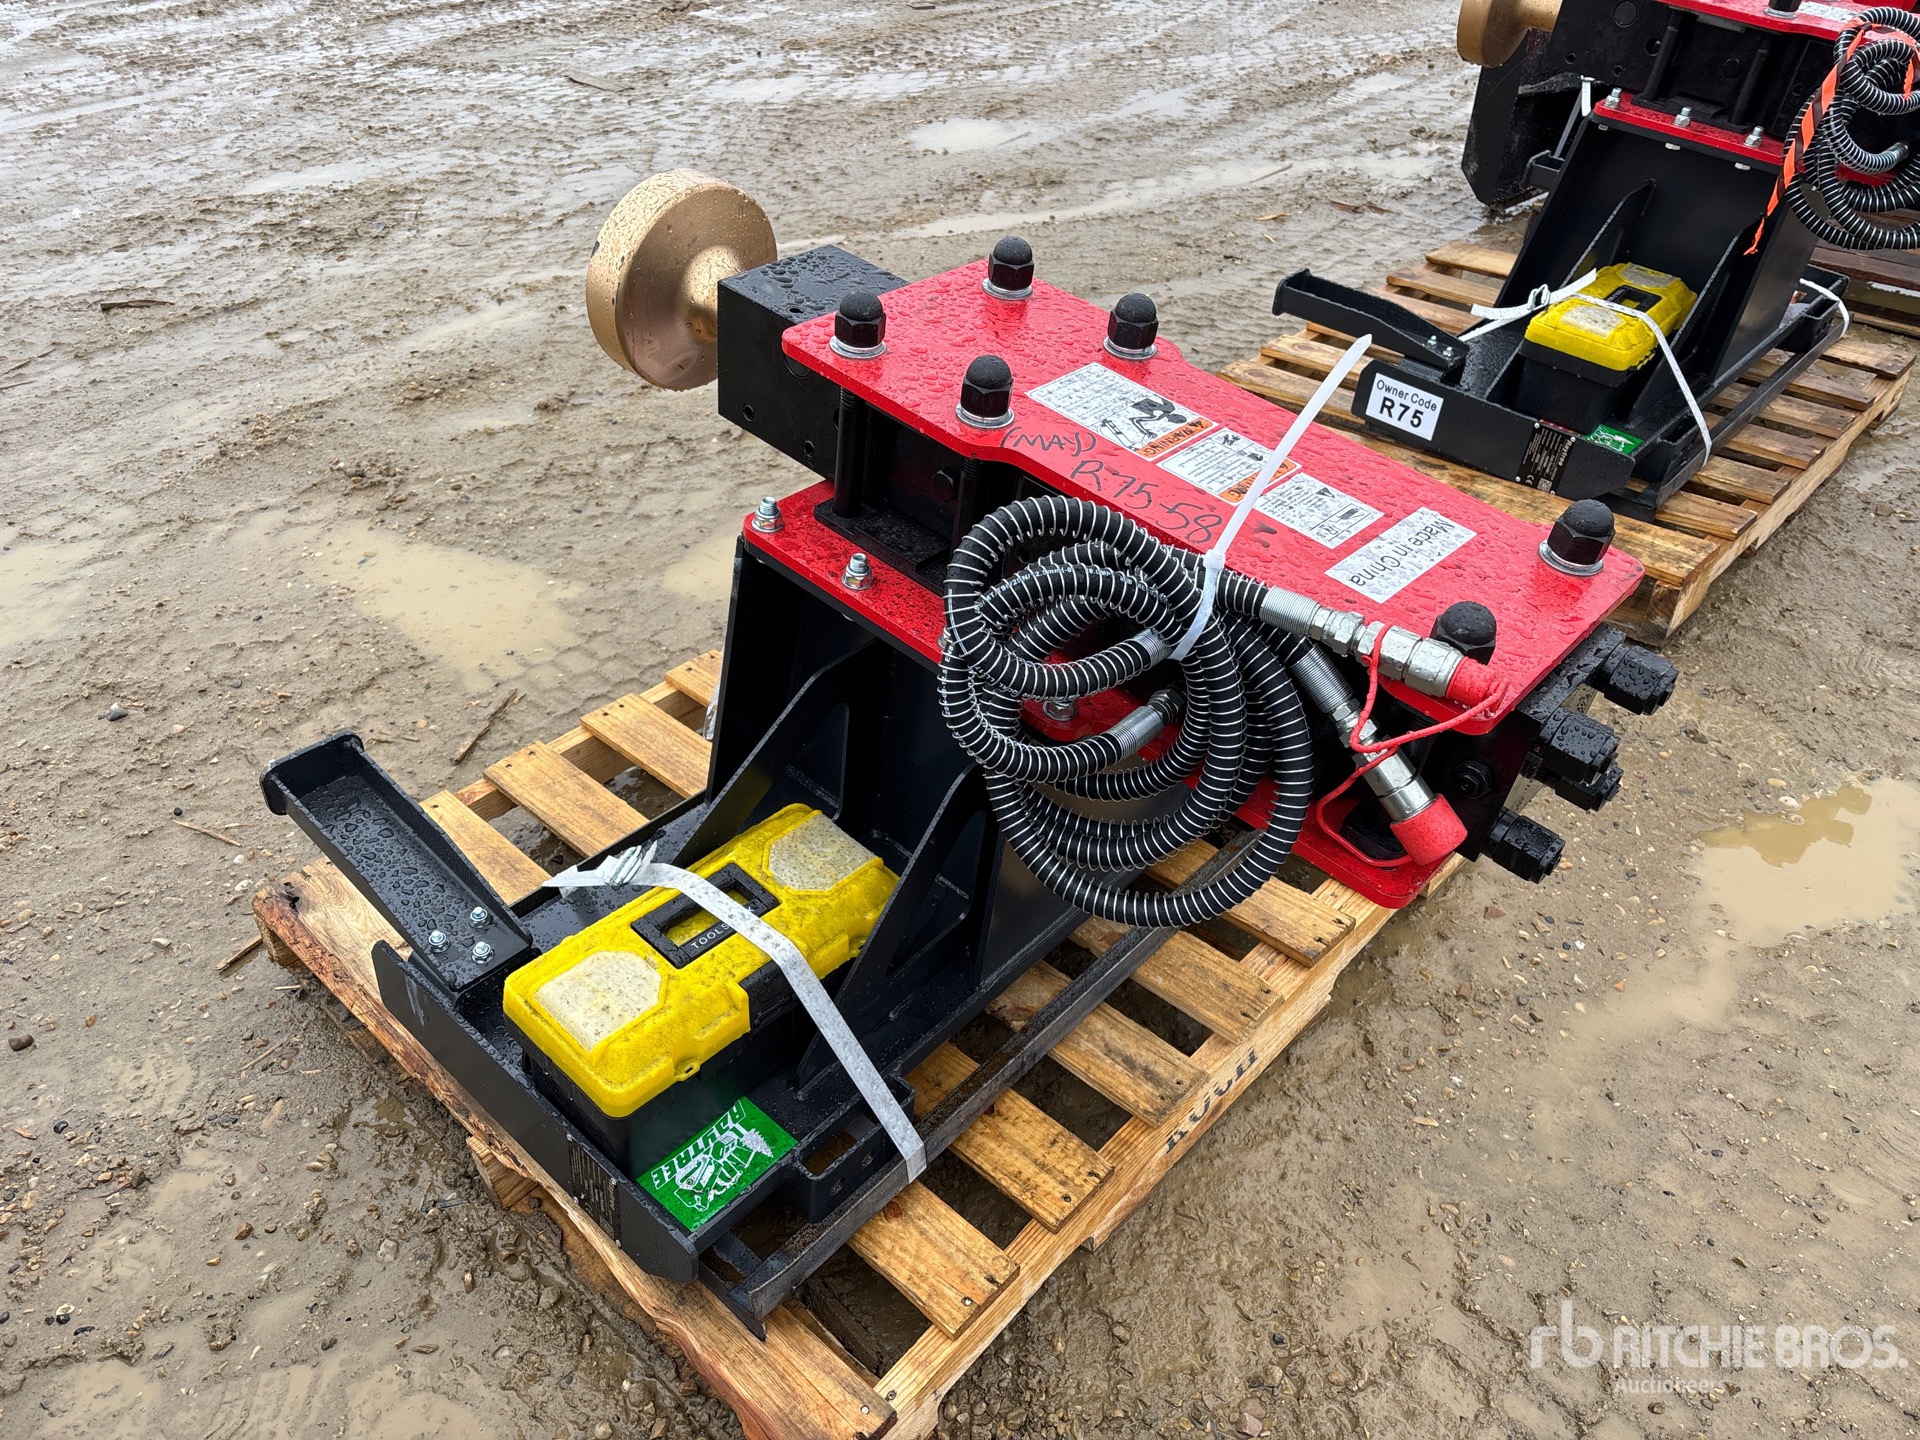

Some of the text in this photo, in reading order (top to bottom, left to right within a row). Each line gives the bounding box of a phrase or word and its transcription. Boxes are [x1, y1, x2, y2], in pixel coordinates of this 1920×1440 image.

[1376, 379, 1437, 412] Owner Code
[1379, 396, 1424, 428] R75
[1143, 426, 1195, 456] WARNING
[1349, 518, 1455, 587] Made in China
[690, 923, 730, 950] TOOLS
[650, 1099, 747, 1190] RAYTREE
